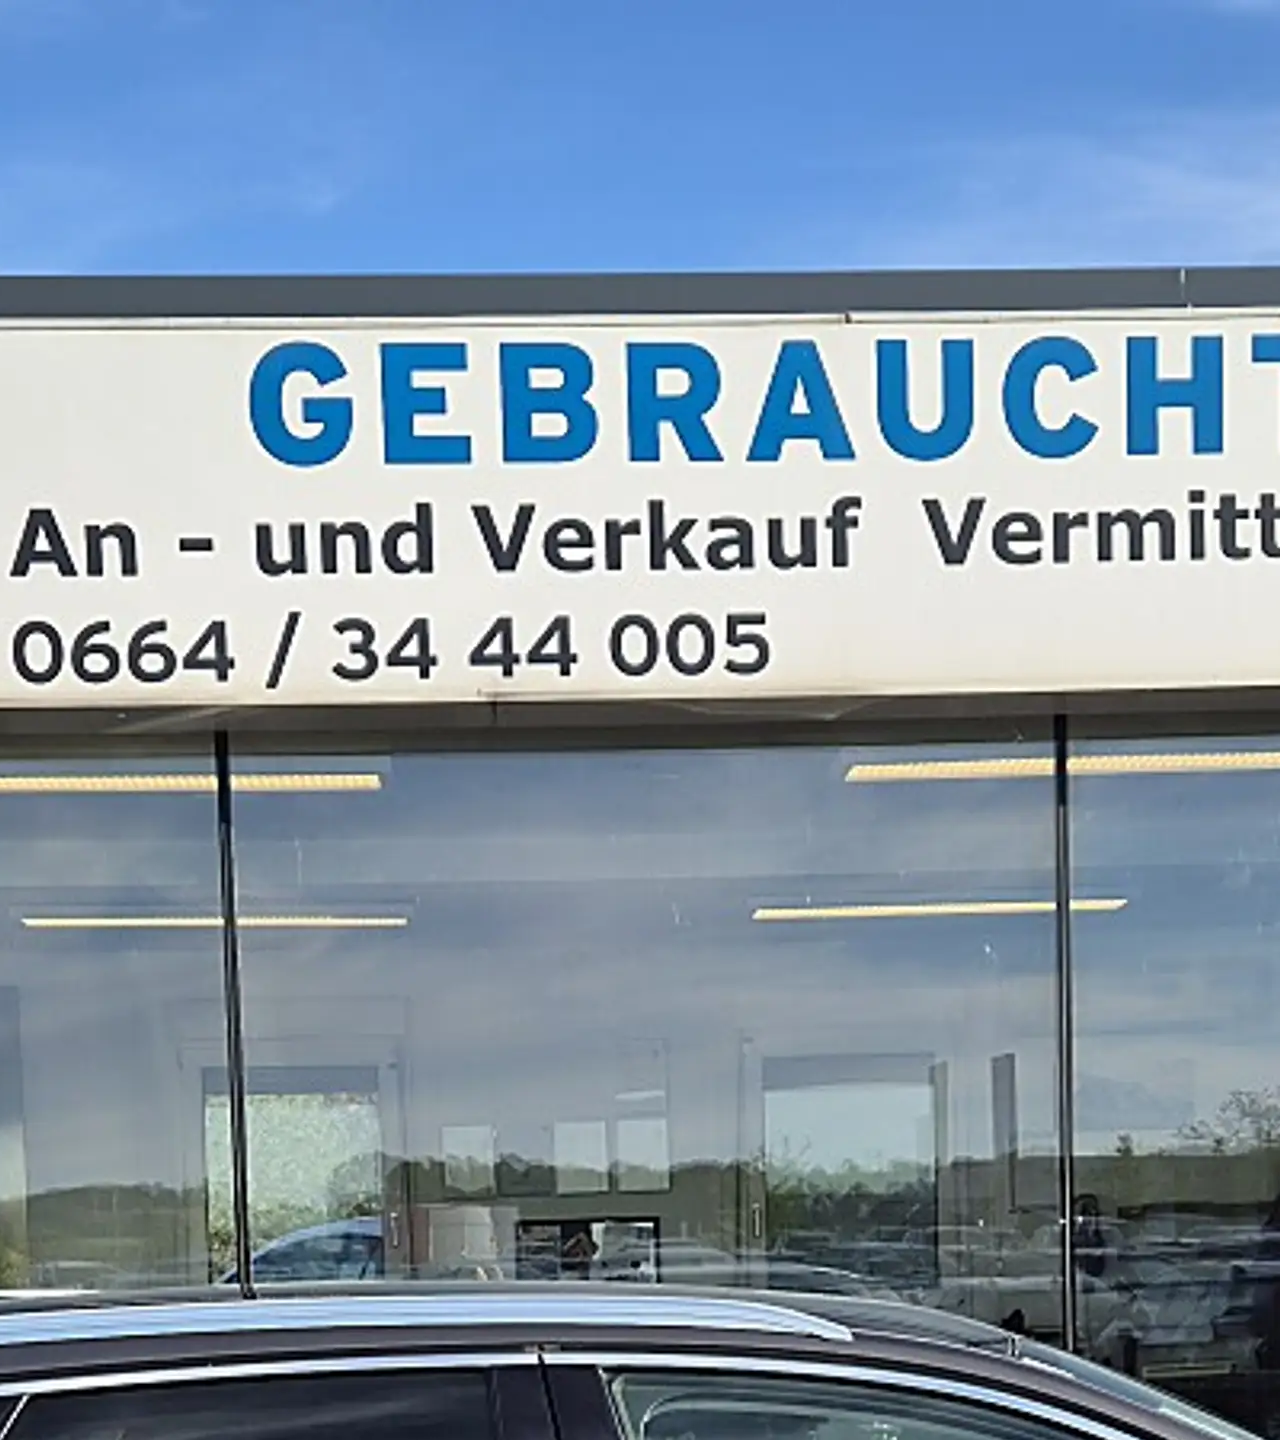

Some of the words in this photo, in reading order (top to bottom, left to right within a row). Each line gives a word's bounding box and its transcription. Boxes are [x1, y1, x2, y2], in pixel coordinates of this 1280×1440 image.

[8, 507, 140, 579] An
[178, 537, 214, 553] -
[255, 500, 435, 578] und
[469, 498, 863, 574] Verkauf
[11, 619, 236, 685] 0664
[265, 611, 302, 690] /
[330, 616, 439, 682] 34
[468, 615, 579, 679] 44
[608, 612, 770, 677] 005
